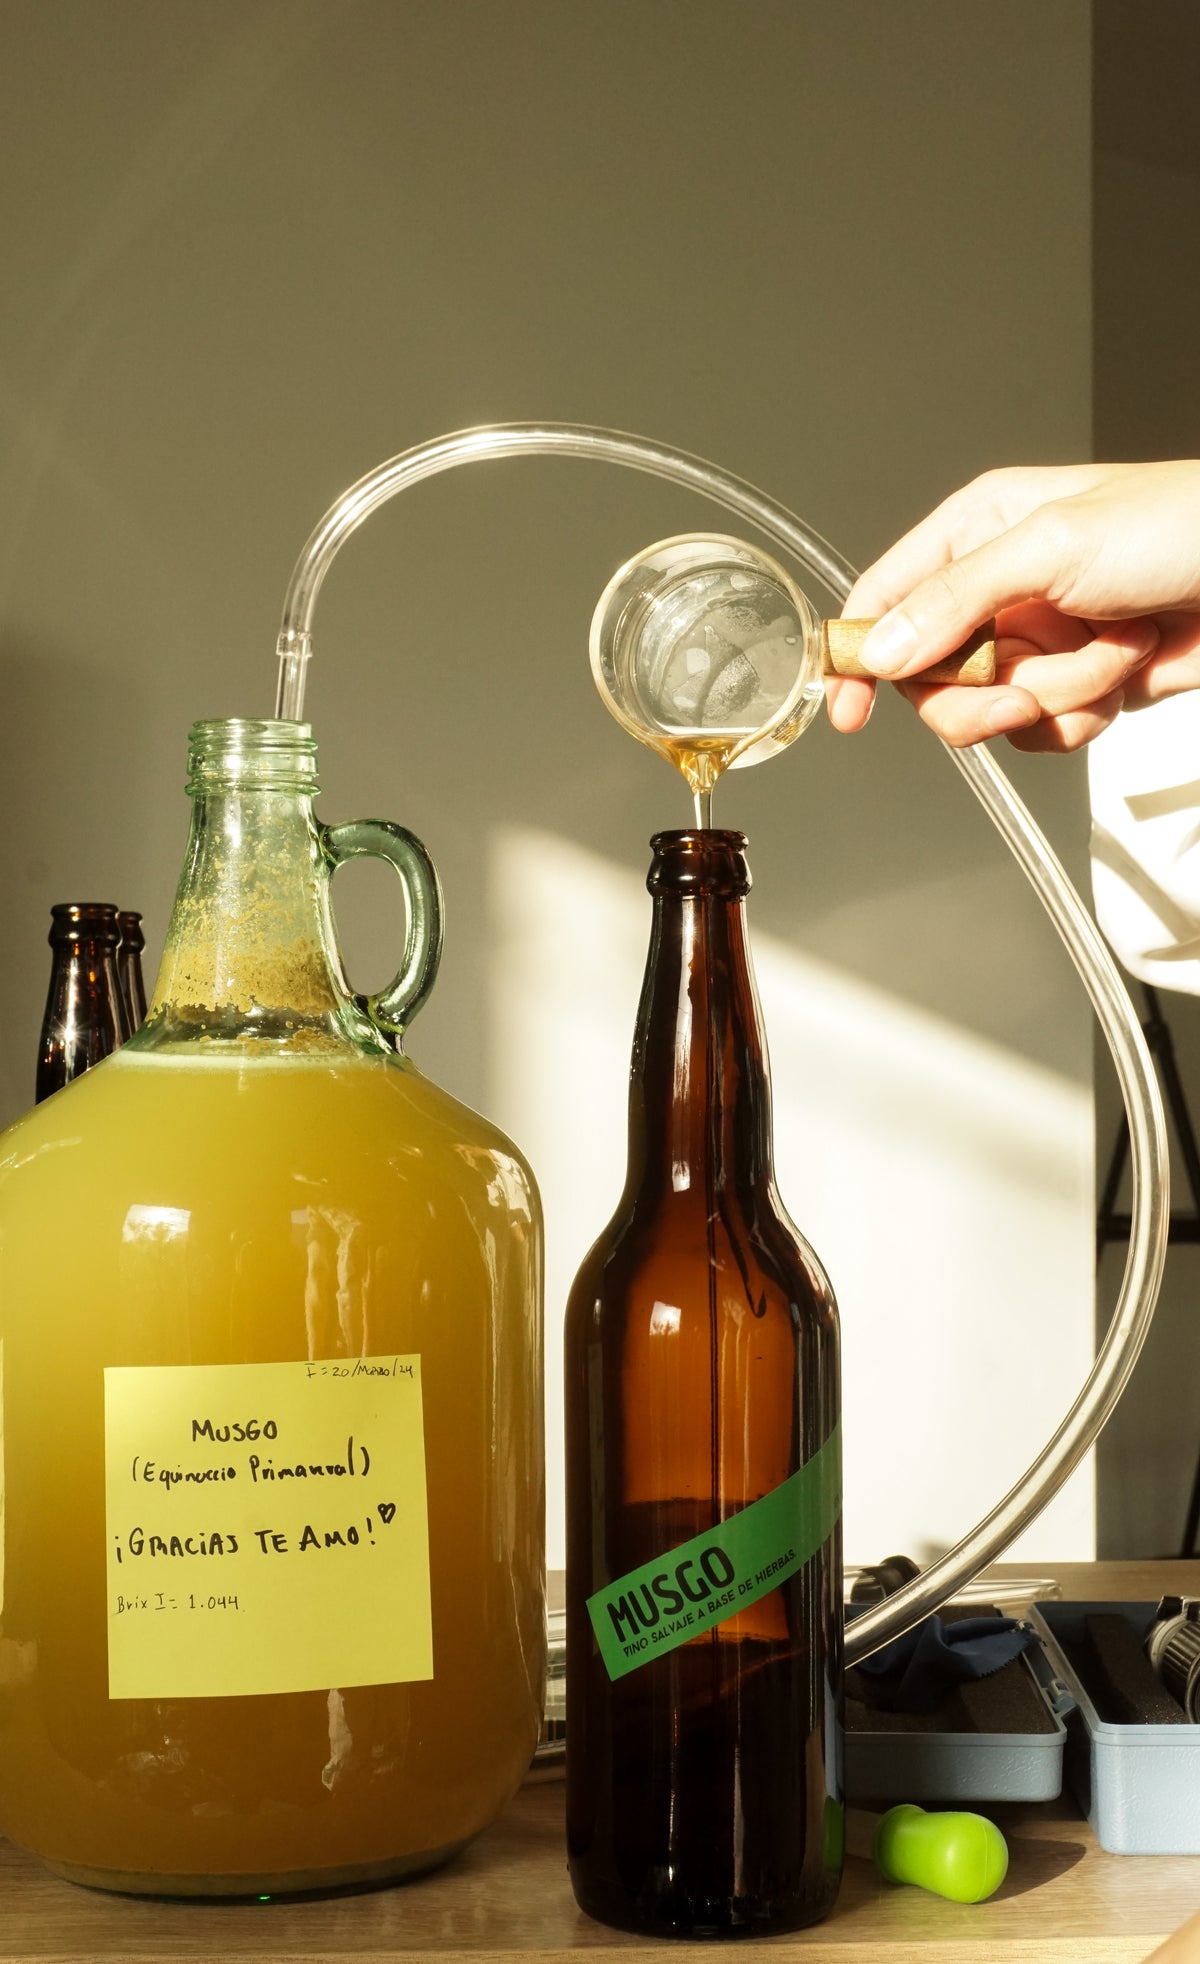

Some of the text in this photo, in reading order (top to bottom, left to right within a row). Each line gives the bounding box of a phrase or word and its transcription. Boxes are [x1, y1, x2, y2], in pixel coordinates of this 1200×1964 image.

[191, 1419, 278, 1442] MUSGO
[255, 1529, 289, 1554] TE
[116, 1595, 147, 1614] Brix
[189, 1594, 239, 1610] 1.044
[606, 1546, 735, 1643] MUSGO
[623, 1637, 649, 1657] VINO
[651, 1613, 695, 1643] SALVAJE
[697, 1608, 706, 1620] A
[707, 1589, 736, 1614] BASE
[737, 1578, 754, 1596] DE
